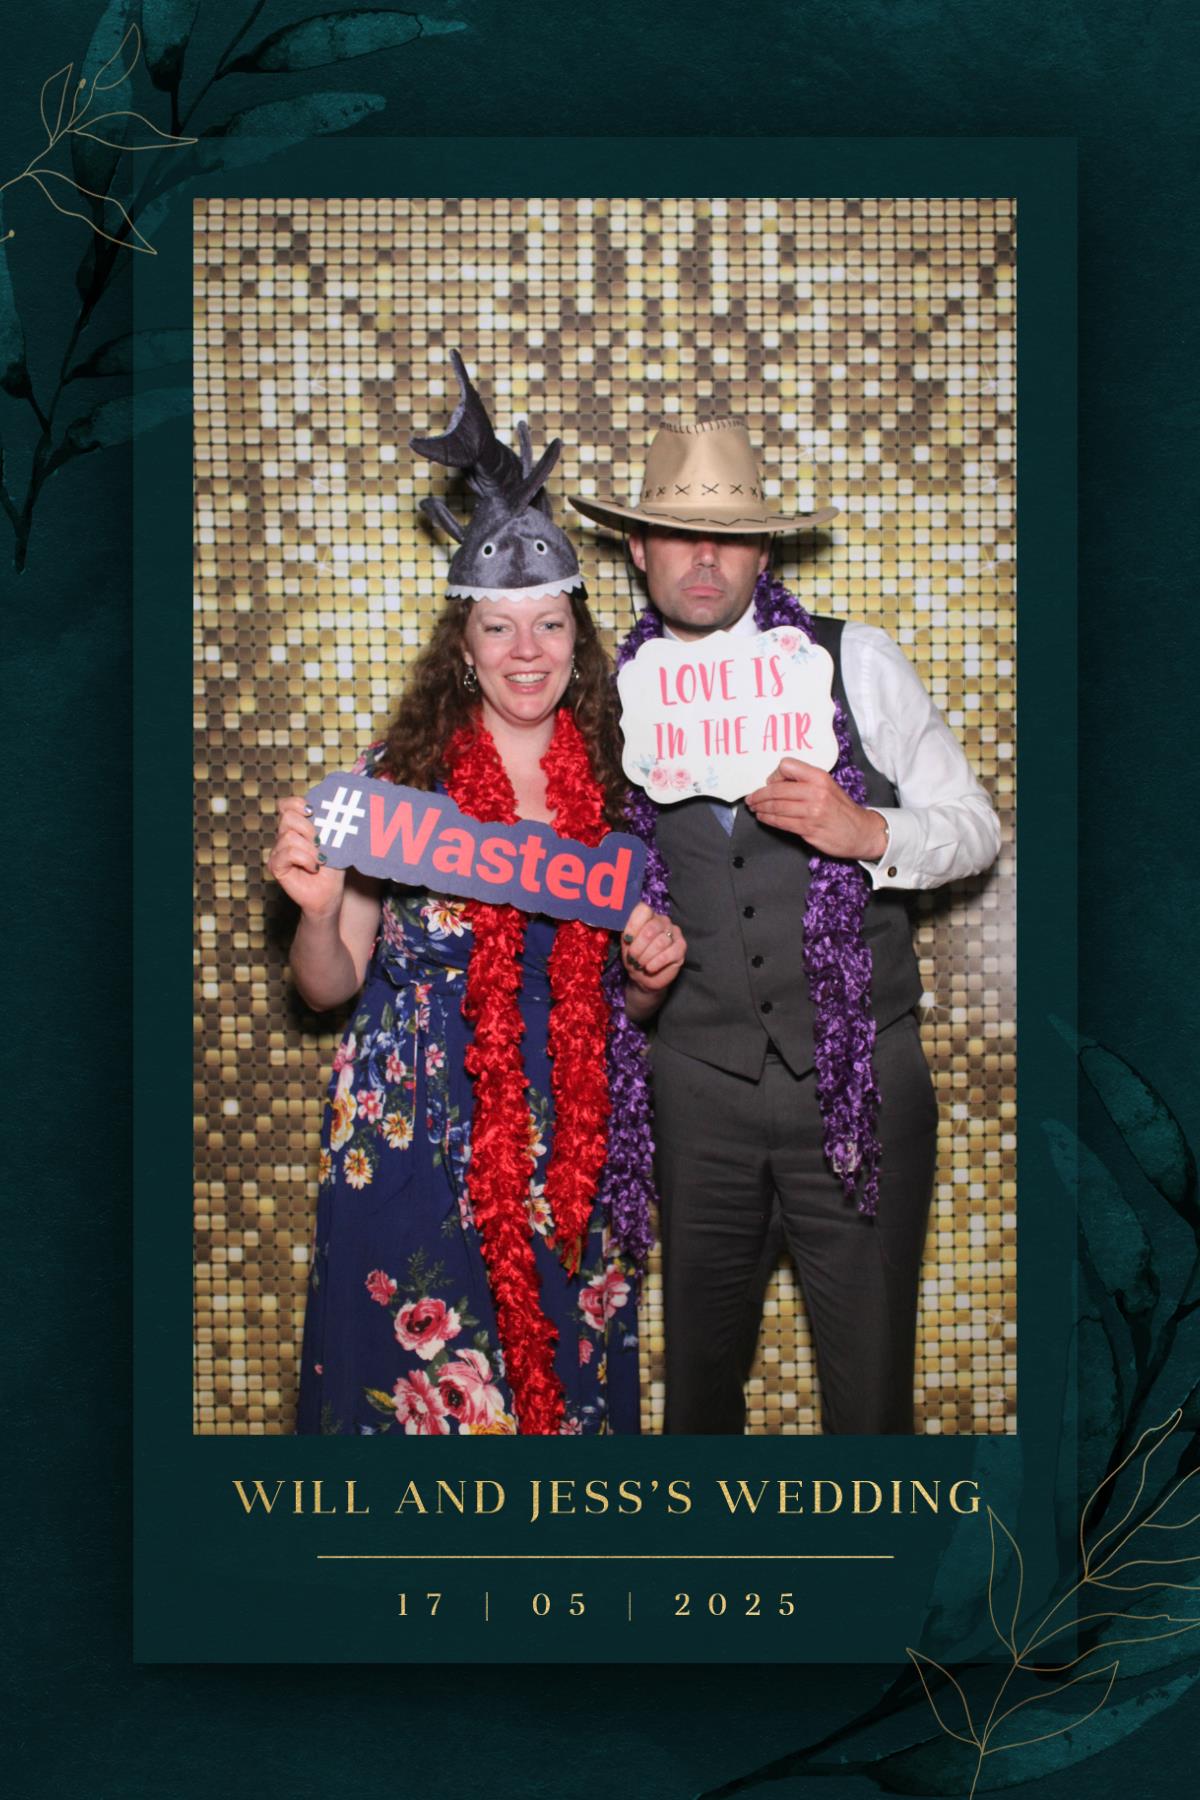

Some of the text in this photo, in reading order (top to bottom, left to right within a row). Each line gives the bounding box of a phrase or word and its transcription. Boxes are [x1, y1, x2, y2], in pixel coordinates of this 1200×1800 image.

[658, 655, 786, 706] LOVE IS
[699, 715, 749, 757] THE
[762, 711, 814, 752] AIR
[313, 786, 633, 911] #Wasted
